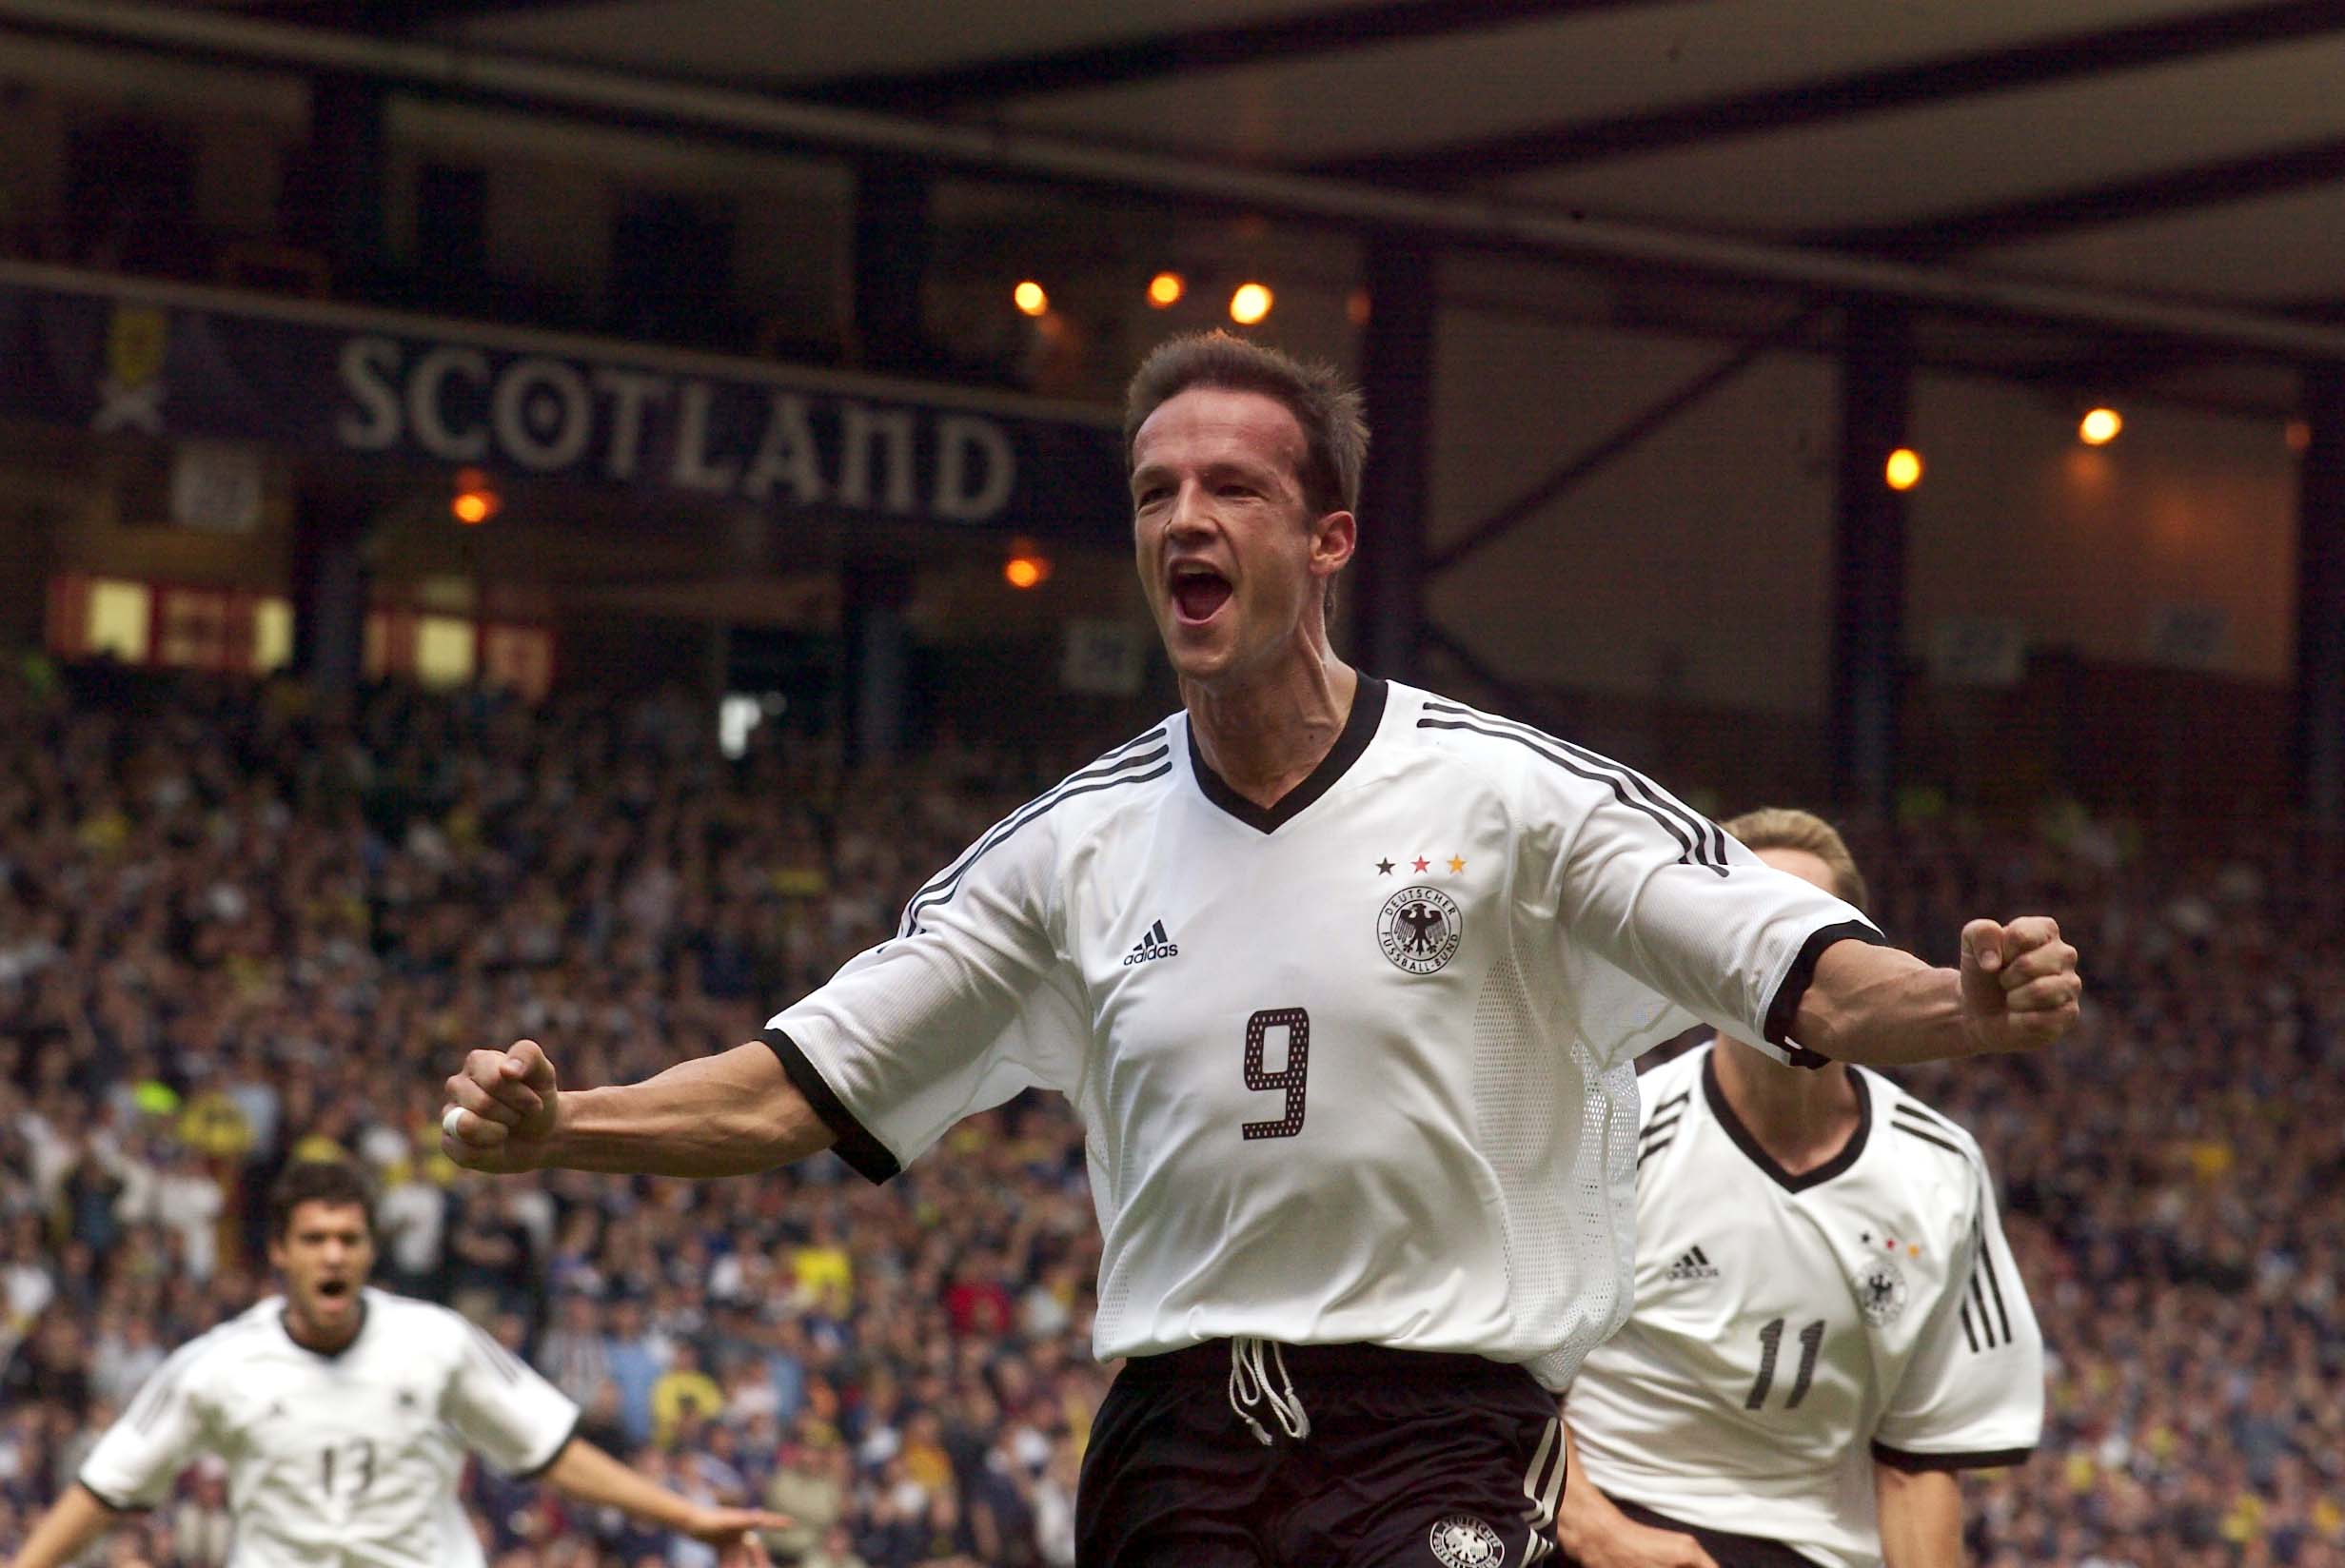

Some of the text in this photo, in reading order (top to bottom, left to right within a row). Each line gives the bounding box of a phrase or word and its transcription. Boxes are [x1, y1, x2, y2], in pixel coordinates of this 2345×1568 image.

[337, 337, 1016, 524] SCOTLAND
[1385, 889, 1457, 916] DEUTSCHER
[1123, 943, 1178, 966] adidas
[1381, 931, 1459, 972] FUSSBALL-BUND
[1242, 1007, 1310, 1141] 9
[1744, 1318, 1827, 1410] 11
[321, 1435, 378, 1500] 13
